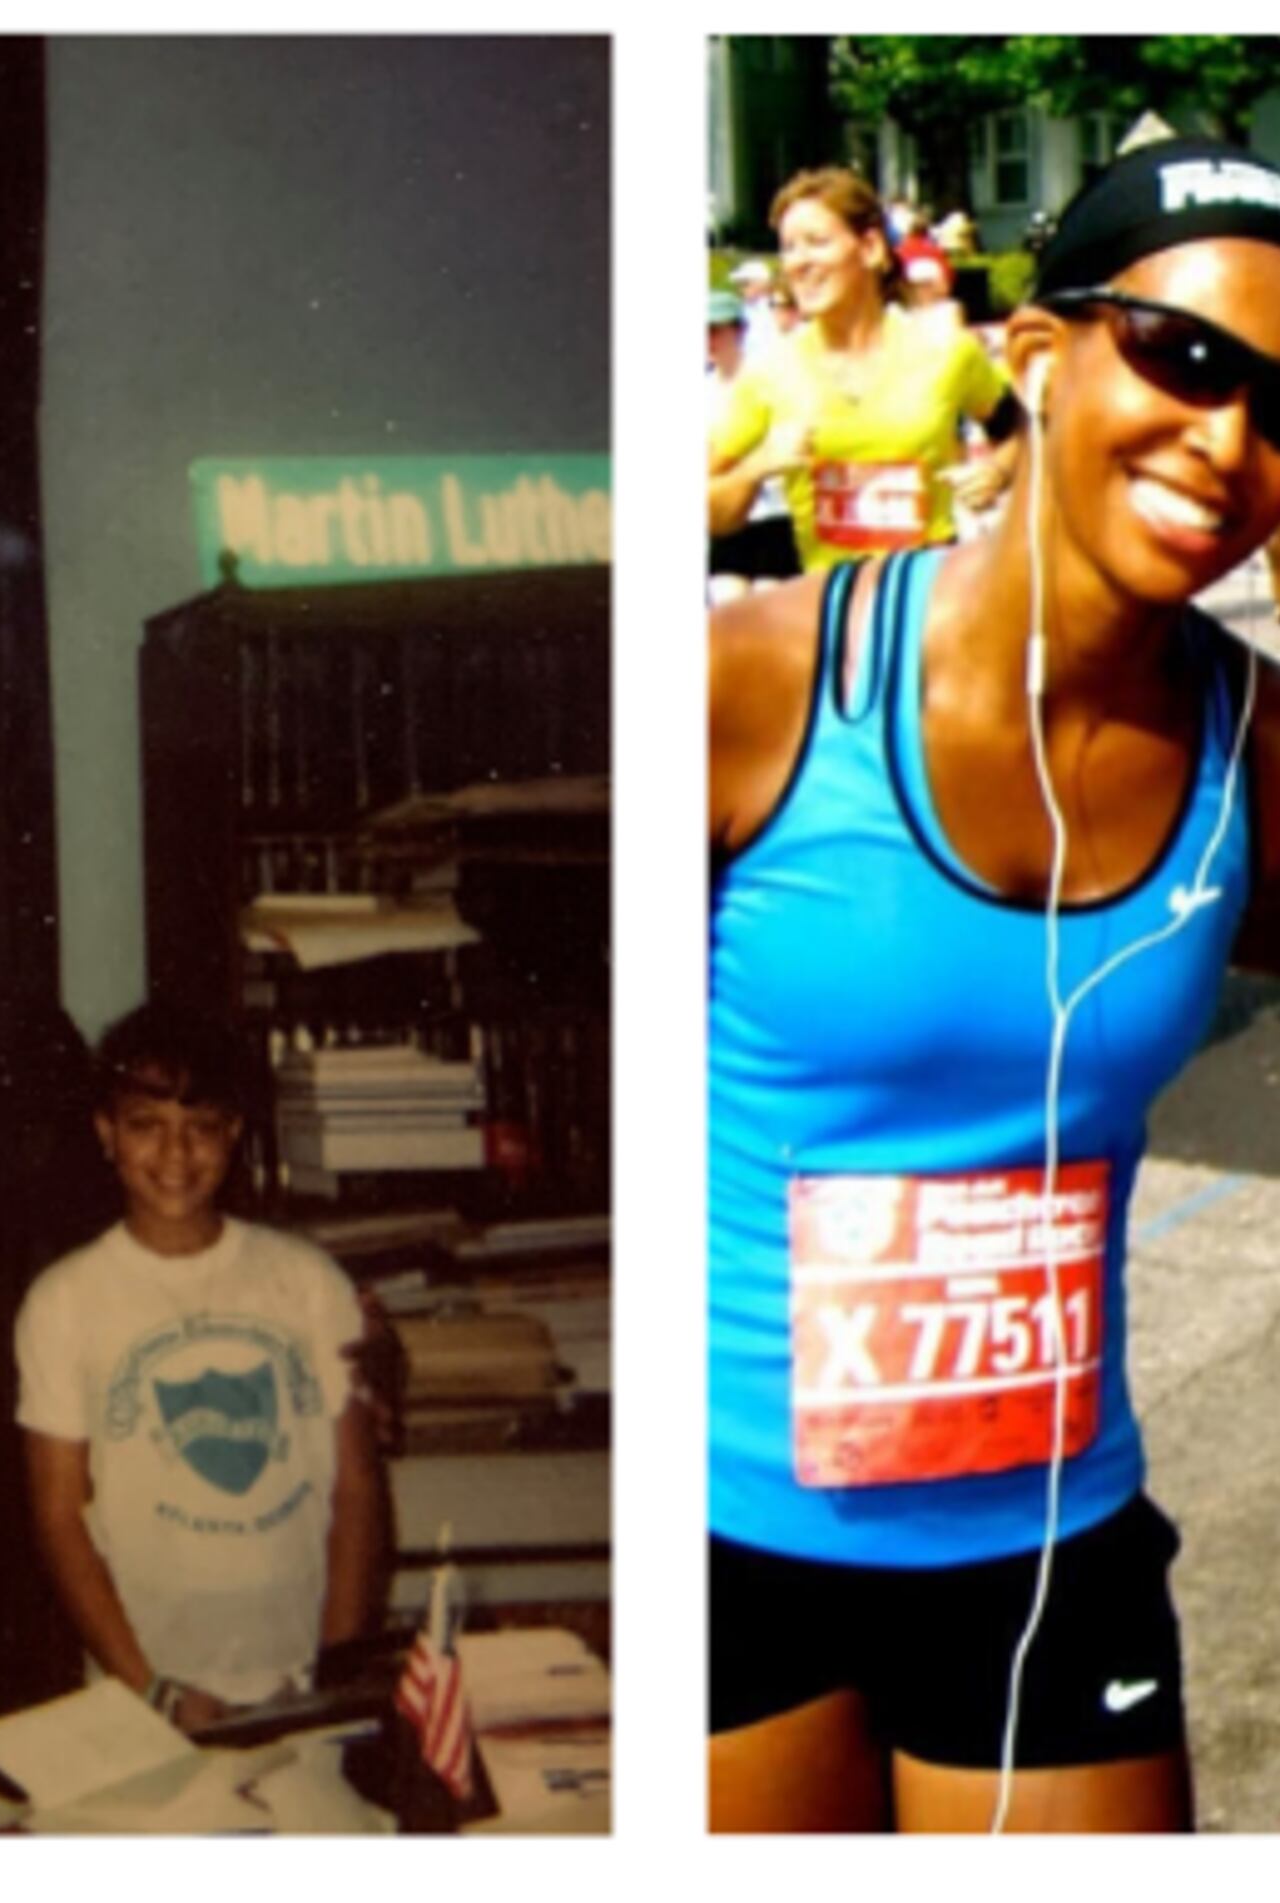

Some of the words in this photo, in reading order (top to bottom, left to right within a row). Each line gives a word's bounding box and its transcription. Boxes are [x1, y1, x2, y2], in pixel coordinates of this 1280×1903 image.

[215, 472, 432, 567] Martin
[813, 1302, 882, 1387] X
[900, 1288, 1089, 1383] 77511
